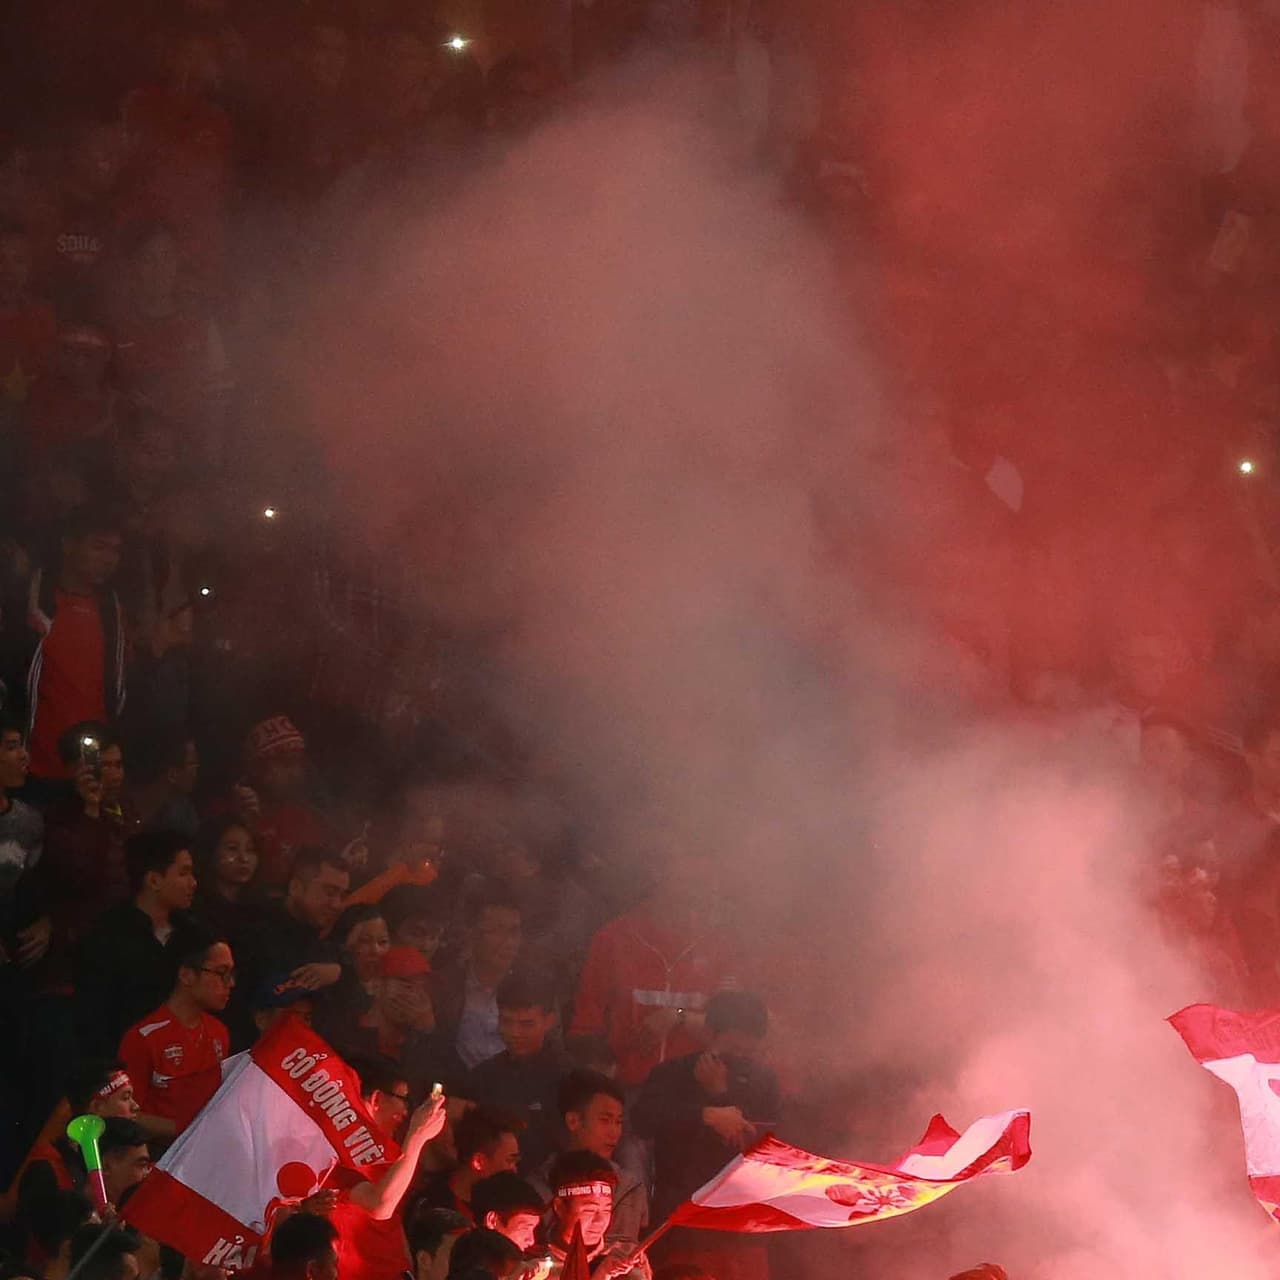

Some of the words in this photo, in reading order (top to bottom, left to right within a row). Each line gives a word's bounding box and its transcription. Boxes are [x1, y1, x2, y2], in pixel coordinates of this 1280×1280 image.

[281, 1047, 328, 1080] CỔ
[301, 1065, 356, 1132] ĐỘNG
[202, 1234, 258, 1271] HẢI
